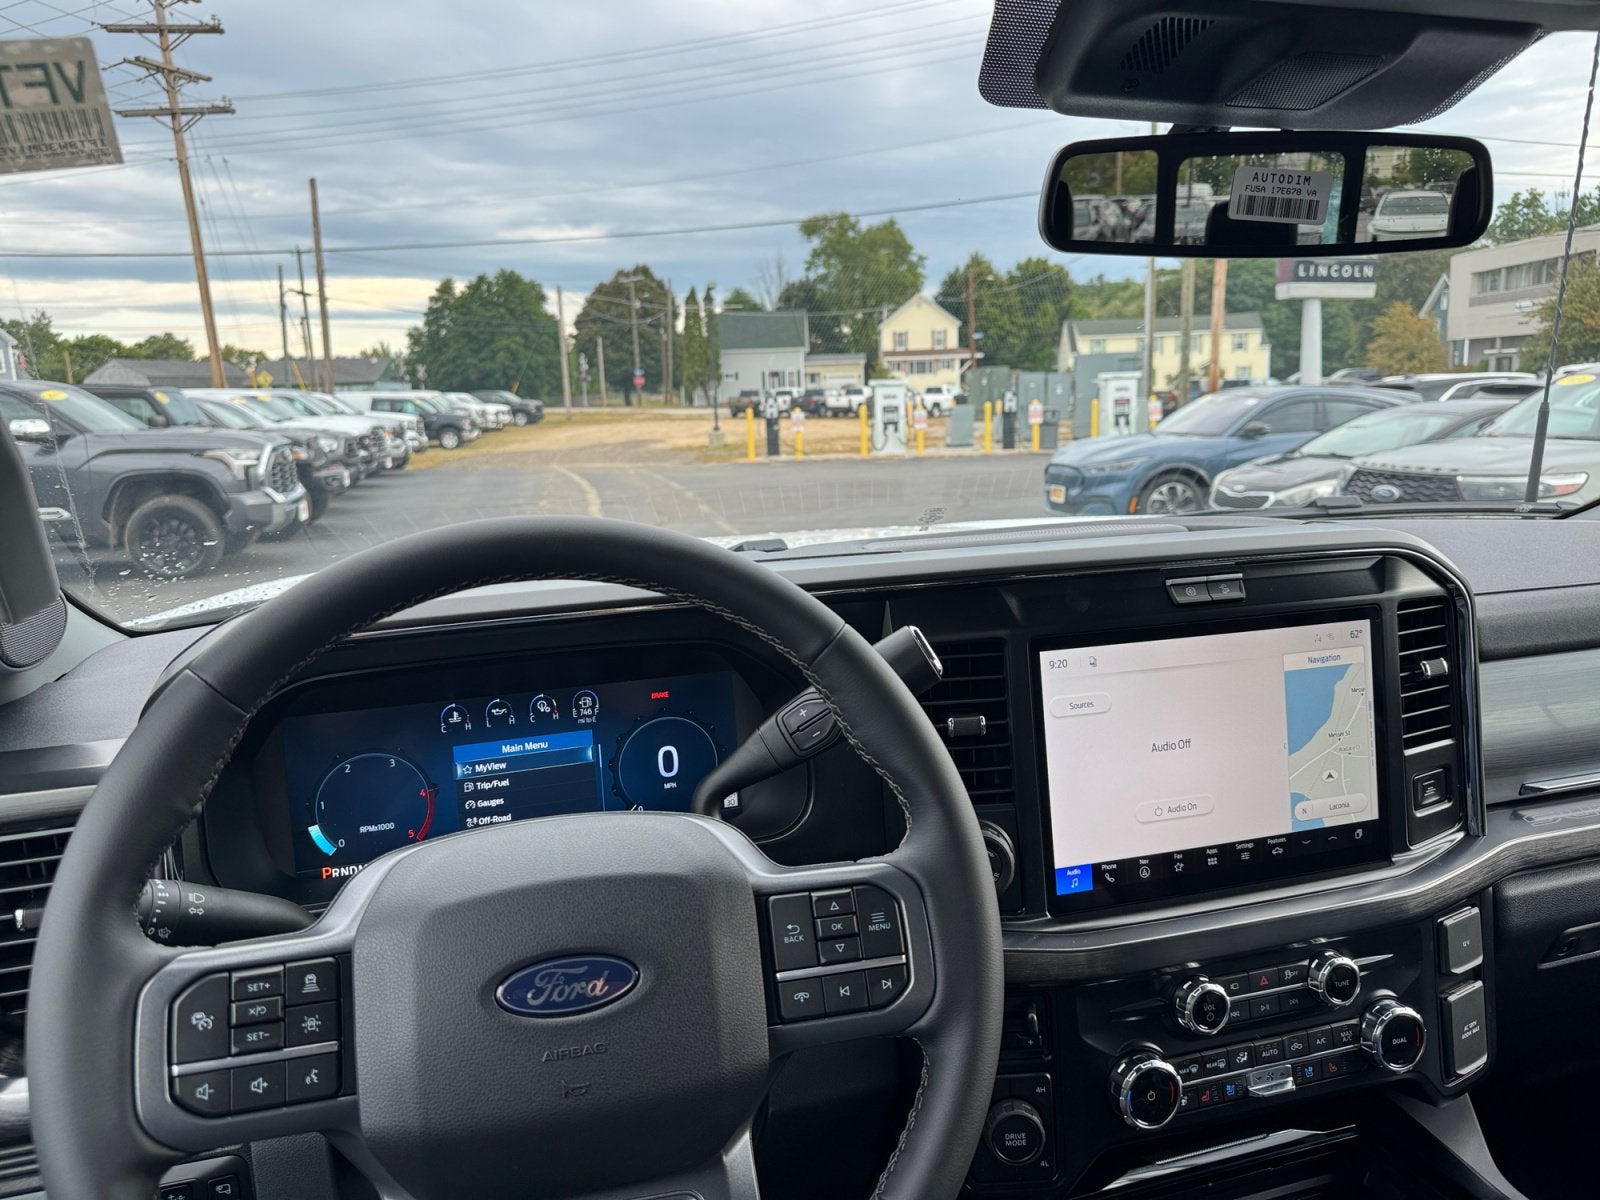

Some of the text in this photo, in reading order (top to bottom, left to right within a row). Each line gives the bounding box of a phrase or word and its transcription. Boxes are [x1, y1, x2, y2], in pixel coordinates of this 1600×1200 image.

[1252, 172, 1311, 186] AUTODIM
[1271, 187, 1302, 195] 17E678
[1307, 189, 1317, 197] VA
[1298, 264, 1374, 277] LINCOLN
[1307, 652, 1341, 664] Navigation
[1048, 658, 1068, 670] 9:20
[651, 691, 669, 699] BRAKE
[1069, 700, 1094, 711] Sources
[580, 708, 593, 716] 746
[502, 741, 548, 753] Main Menu
[1151, 738, 1191, 753] Audio Off
[389, 759, 395, 767] 3
[658, 745, 679, 777] 0
[345, 764, 350, 773] 2
[475, 762, 507, 773] MyView
[476, 778, 510, 790] Trip/Fuel
[320, 801, 325, 809] 1
[477, 798, 504, 807] Gauges
[1329, 801, 1350, 810] Laconia
[1167, 801, 1197, 814] Audio On
[478, 813, 512, 825] Off-Road
[360, 822, 395, 833] RPMx1000
[408, 829, 414, 838] 5
[338, 838, 345, 847] 0
[1236, 842, 1255, 850] Settings
[868, 922, 891, 931] MENU
[784, 935, 804, 943] BACK
[527, 965, 609, 1006] Ford
[1204, 1003, 1216, 1011] VOL
[1316, 1037, 1326, 1045] A/C
[1392, 1037, 1407, 1045] DUAL
[542, 1042, 608, 1062] AIRBAG
[1262, 1048, 1279, 1057] AUTO
[1004, 1132, 1026, 1140] DRIVE
